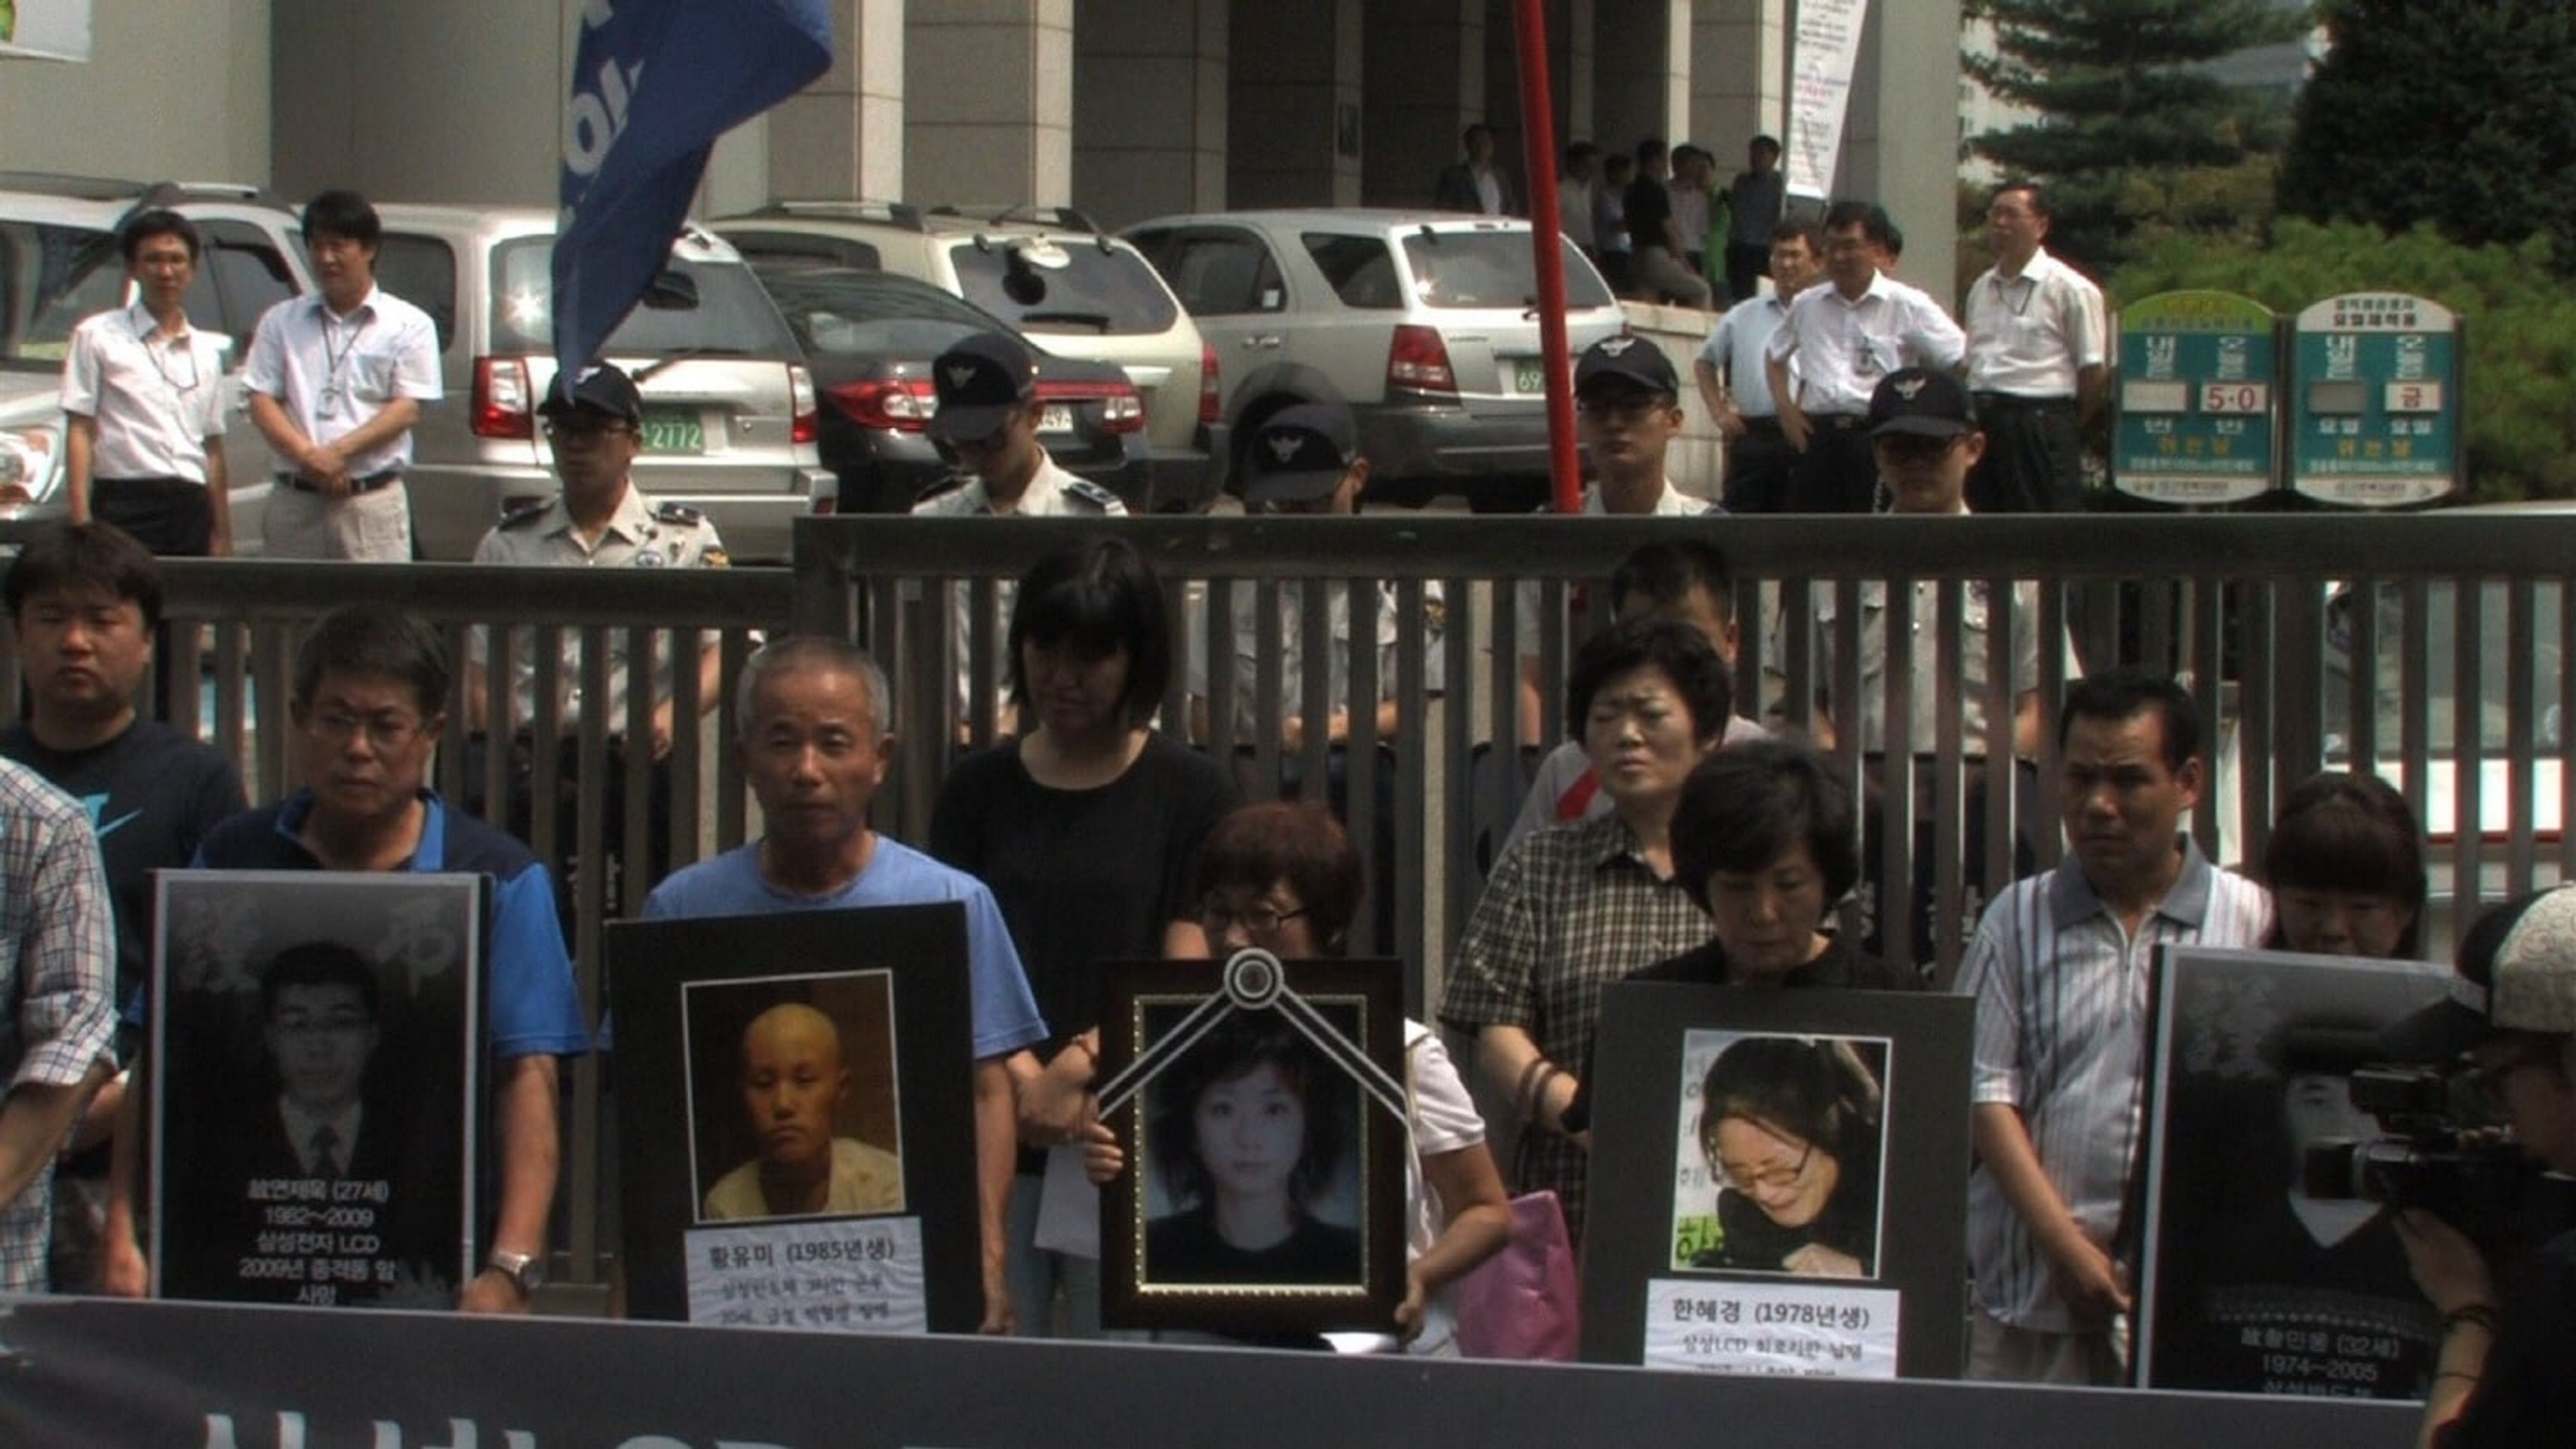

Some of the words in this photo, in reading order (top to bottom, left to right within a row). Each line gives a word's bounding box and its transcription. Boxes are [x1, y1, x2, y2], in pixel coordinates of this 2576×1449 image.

[2401, 386, 2423, 408] 금
[651, 423, 702, 449] 2772
[340, 1234, 380, 1254] LCD
[710, 1244, 774, 1271] 황유미
[785, 1236, 896, 1266] (1985년생)
[1673, 1297, 1741, 1324] 한혜경
[1754, 1302, 1871, 1331] (1978년생)
